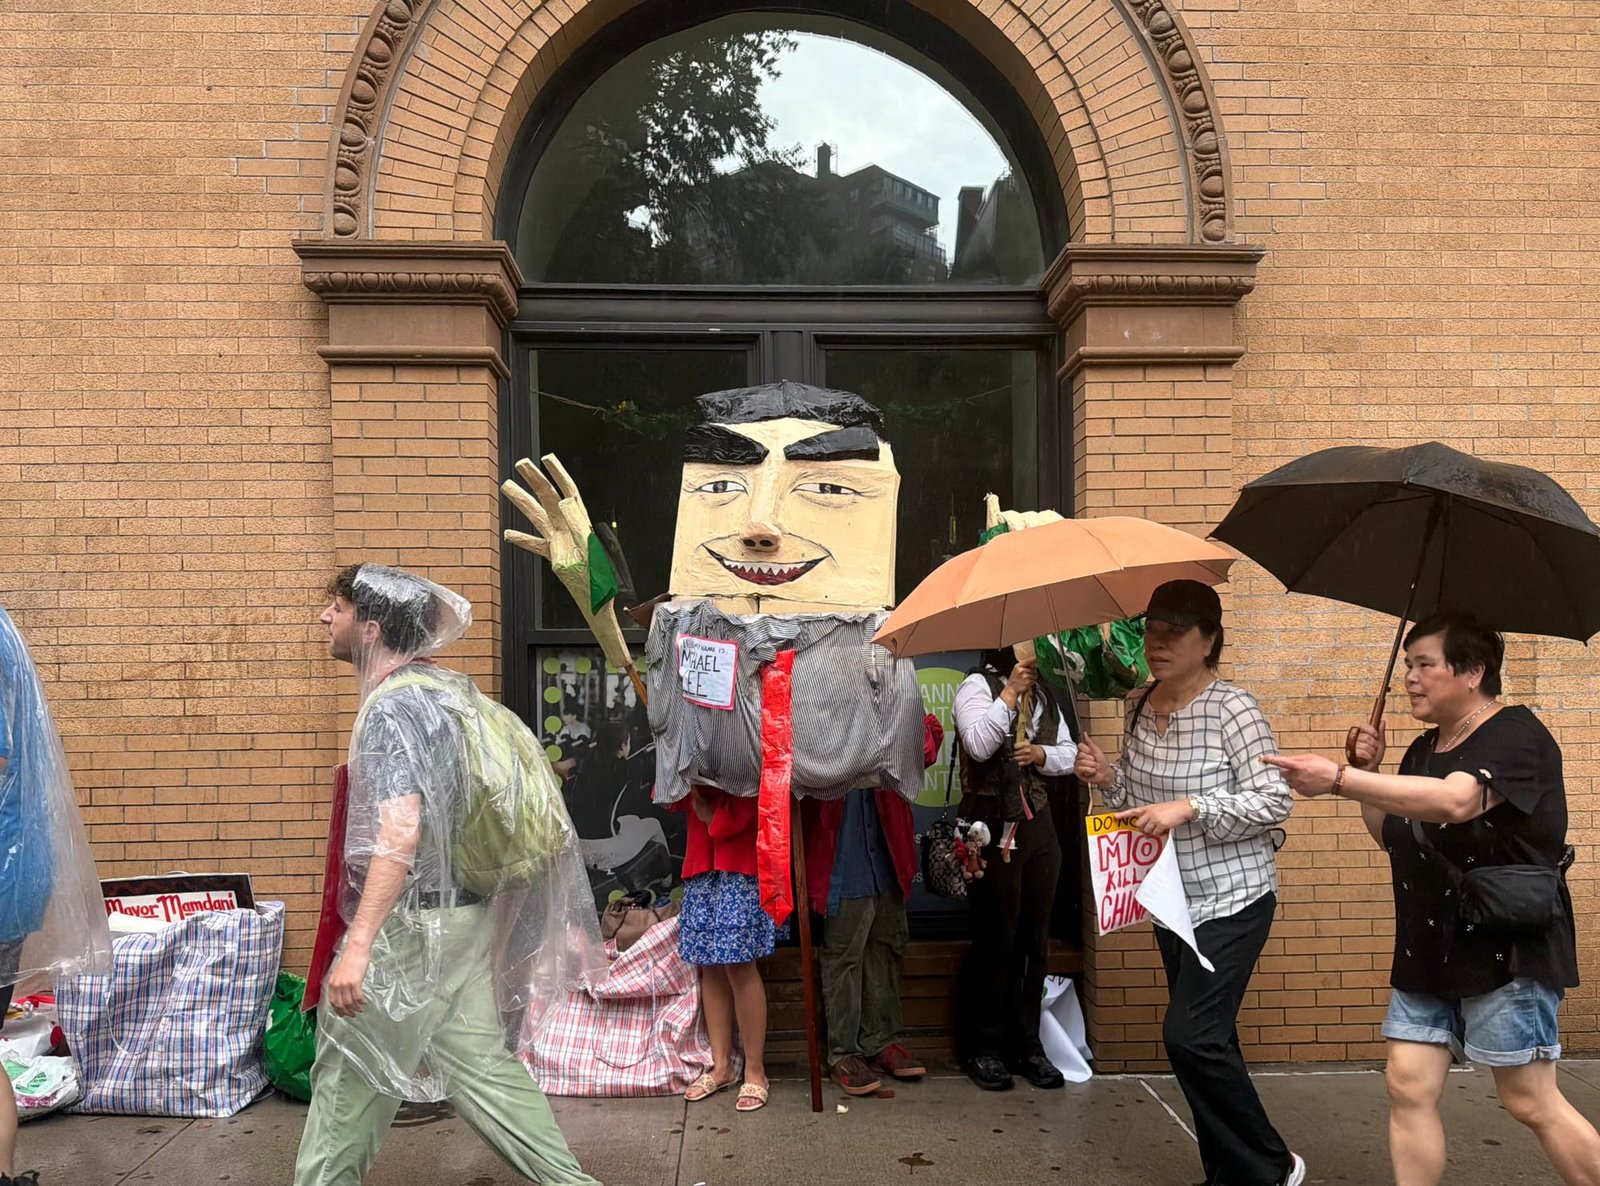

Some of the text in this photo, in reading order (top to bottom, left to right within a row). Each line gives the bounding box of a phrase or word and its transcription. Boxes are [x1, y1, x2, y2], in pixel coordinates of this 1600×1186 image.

[920, 683, 961, 703] ANN
[1093, 815, 1139, 832] DO NO
[1106, 867, 1151, 893] KILL
[104, 893, 235, 922] Mayor Mamdani
[1101, 889, 1147, 931] CHIN
